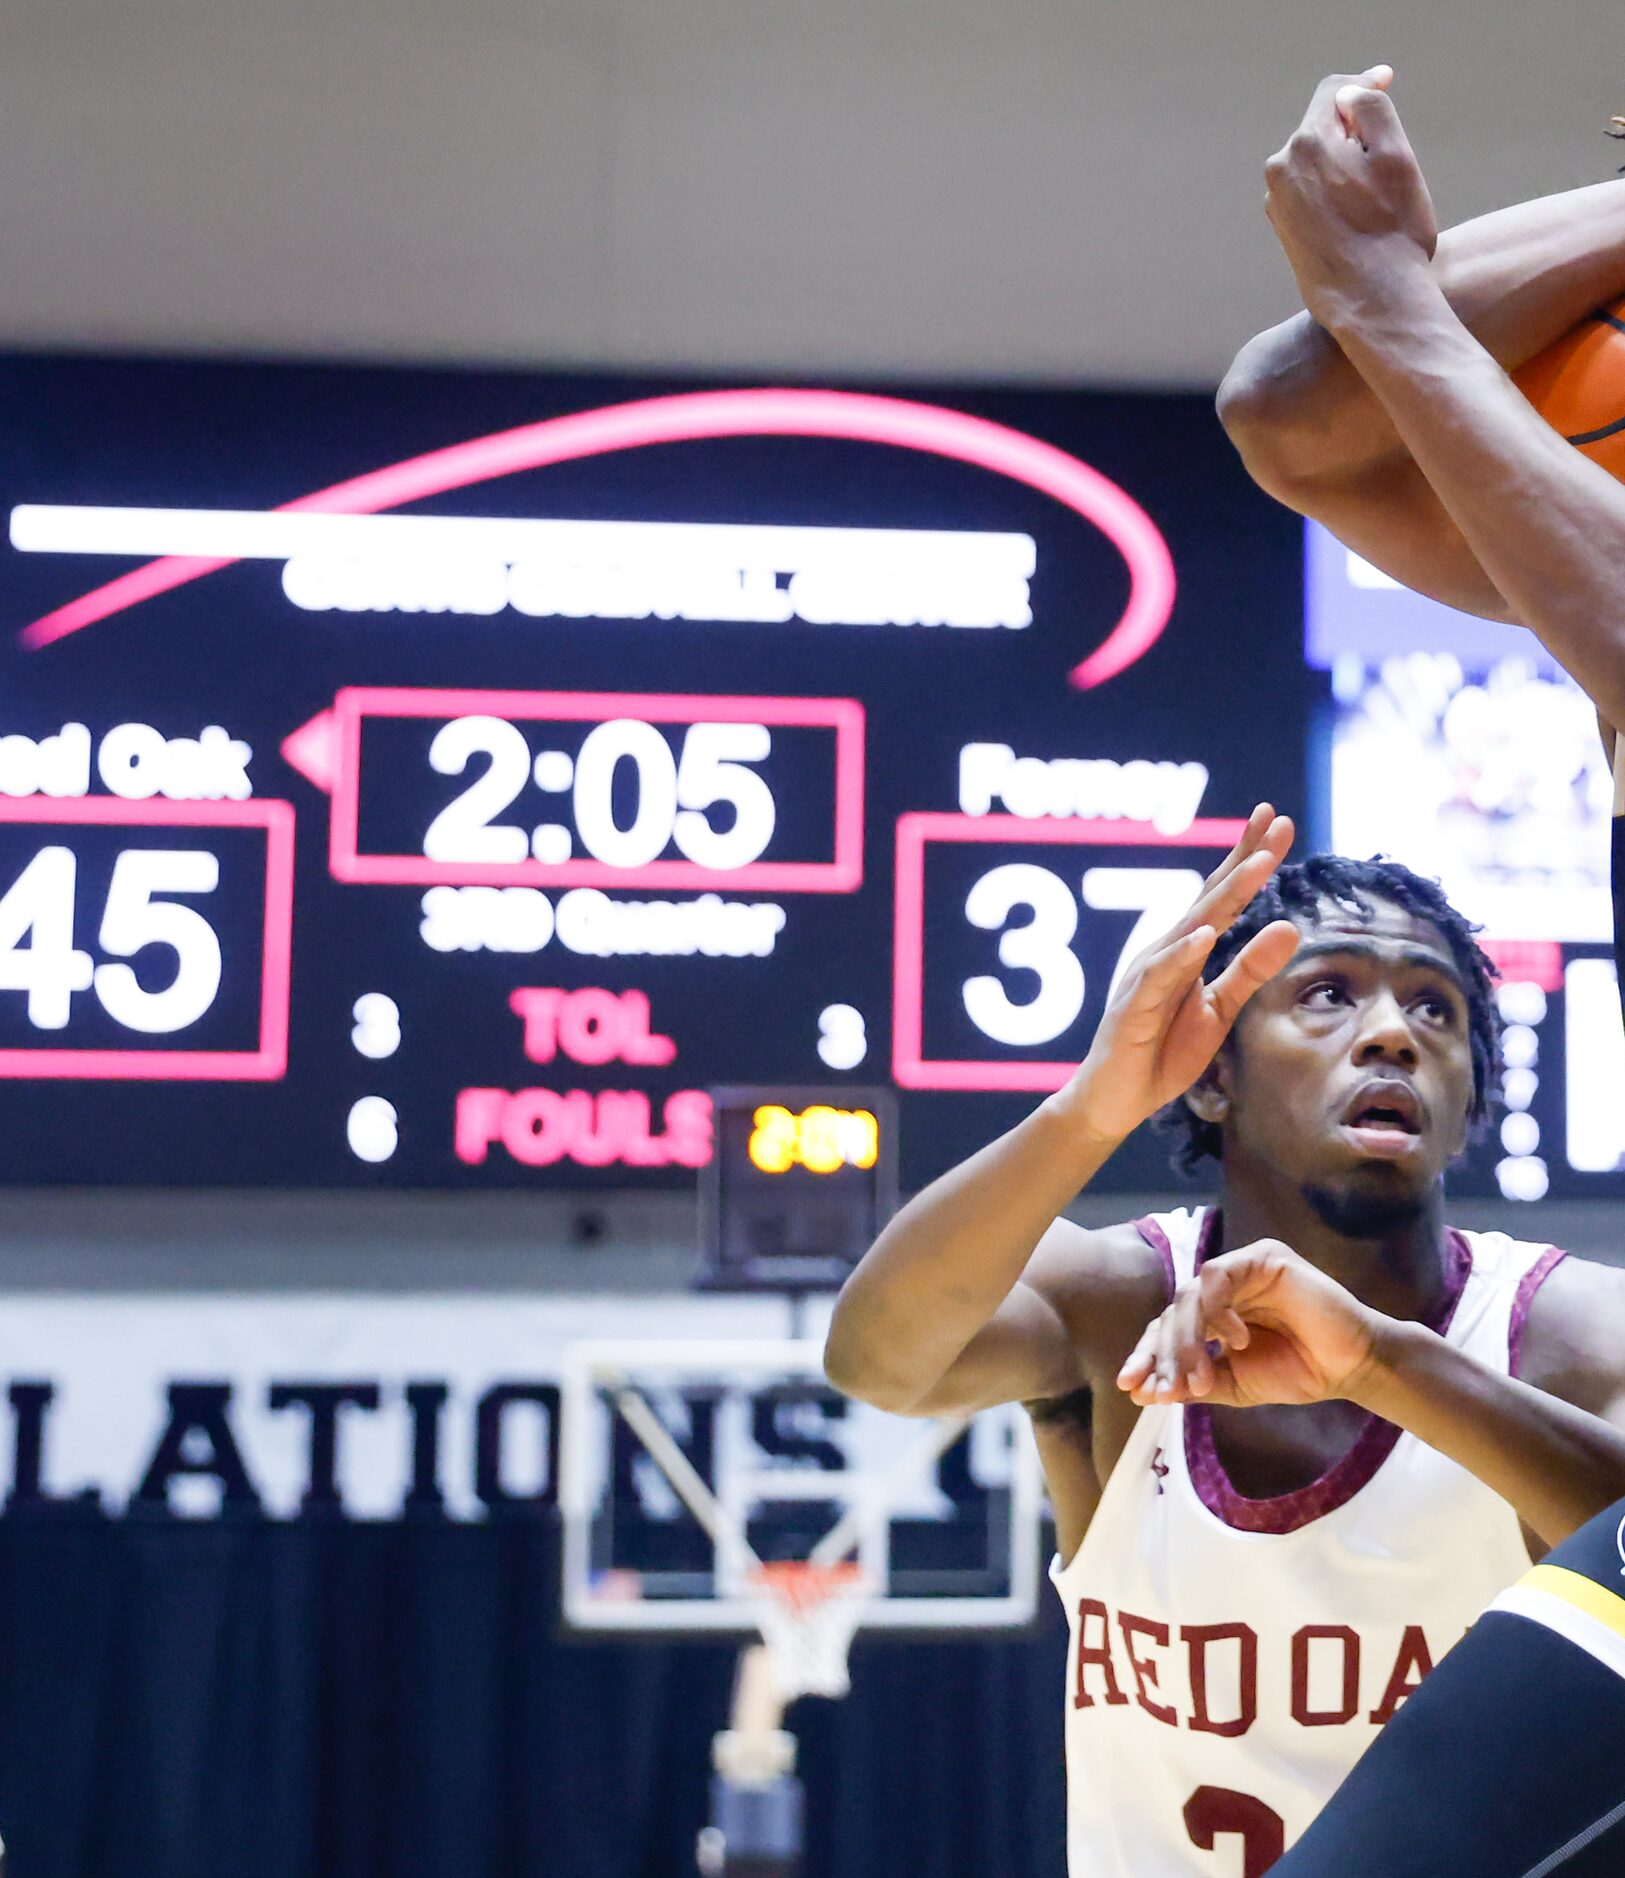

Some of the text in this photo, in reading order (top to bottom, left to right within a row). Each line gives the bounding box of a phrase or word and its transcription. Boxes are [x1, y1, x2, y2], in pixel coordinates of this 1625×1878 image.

[98, 722, 253, 800] Oak
[423, 715, 776, 870] 2:05
[0, 845, 222, 1033] 45
[963, 862, 1206, 1046] 37
[509, 987, 677, 1065] TOL
[454, 1086, 714, 1168] FOULS
[1074, 1598, 1475, 1738] RED OA
